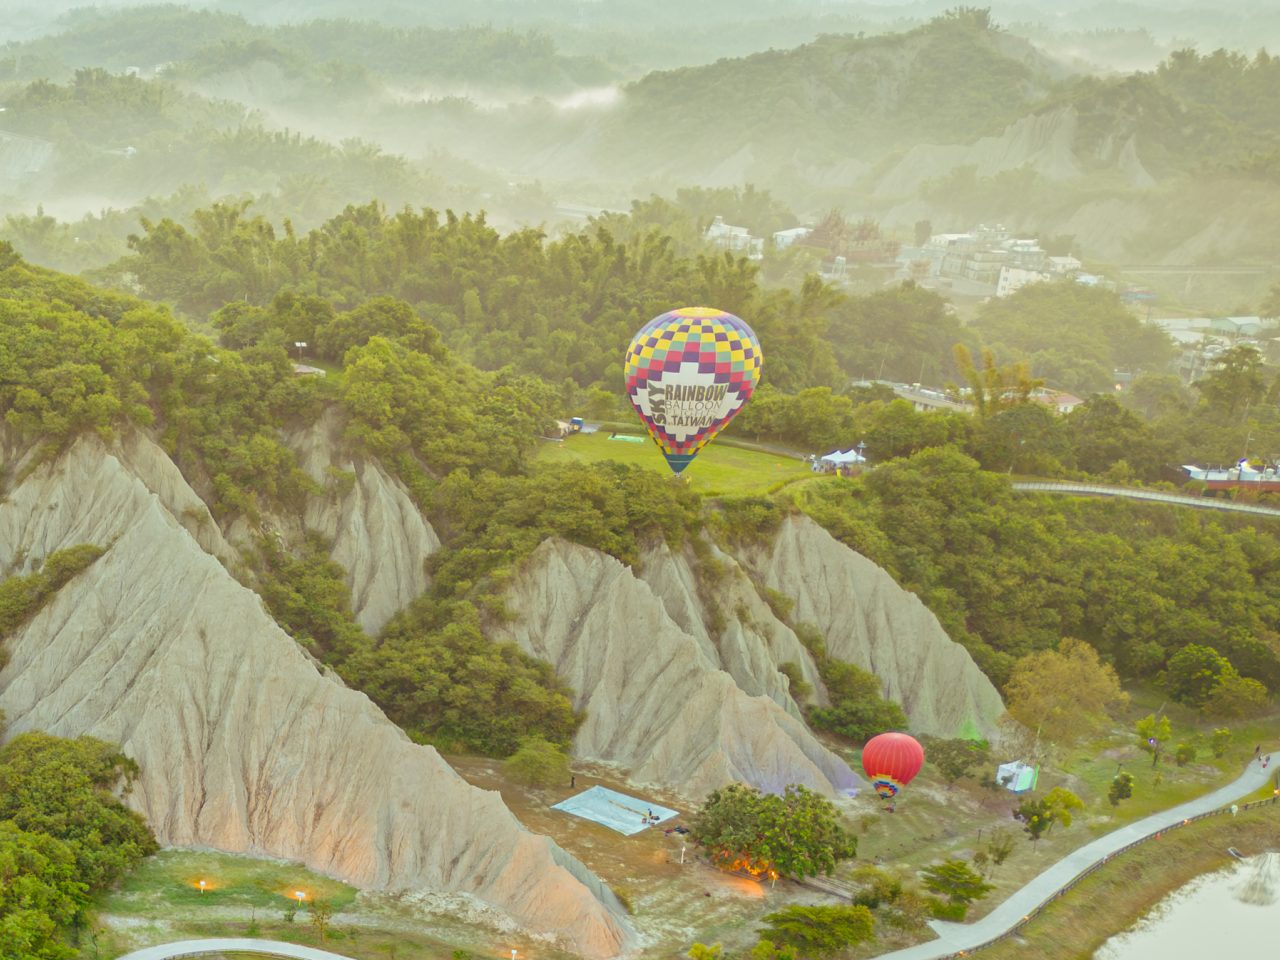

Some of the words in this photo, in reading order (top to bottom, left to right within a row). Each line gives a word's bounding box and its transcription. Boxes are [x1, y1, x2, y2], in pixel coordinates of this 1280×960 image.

[665, 384, 728, 401] RAINBOW
[647, 381, 666, 425] SKY
[664, 400, 722, 411] BALLOON
[671, 415, 715, 427] TAIWAN
